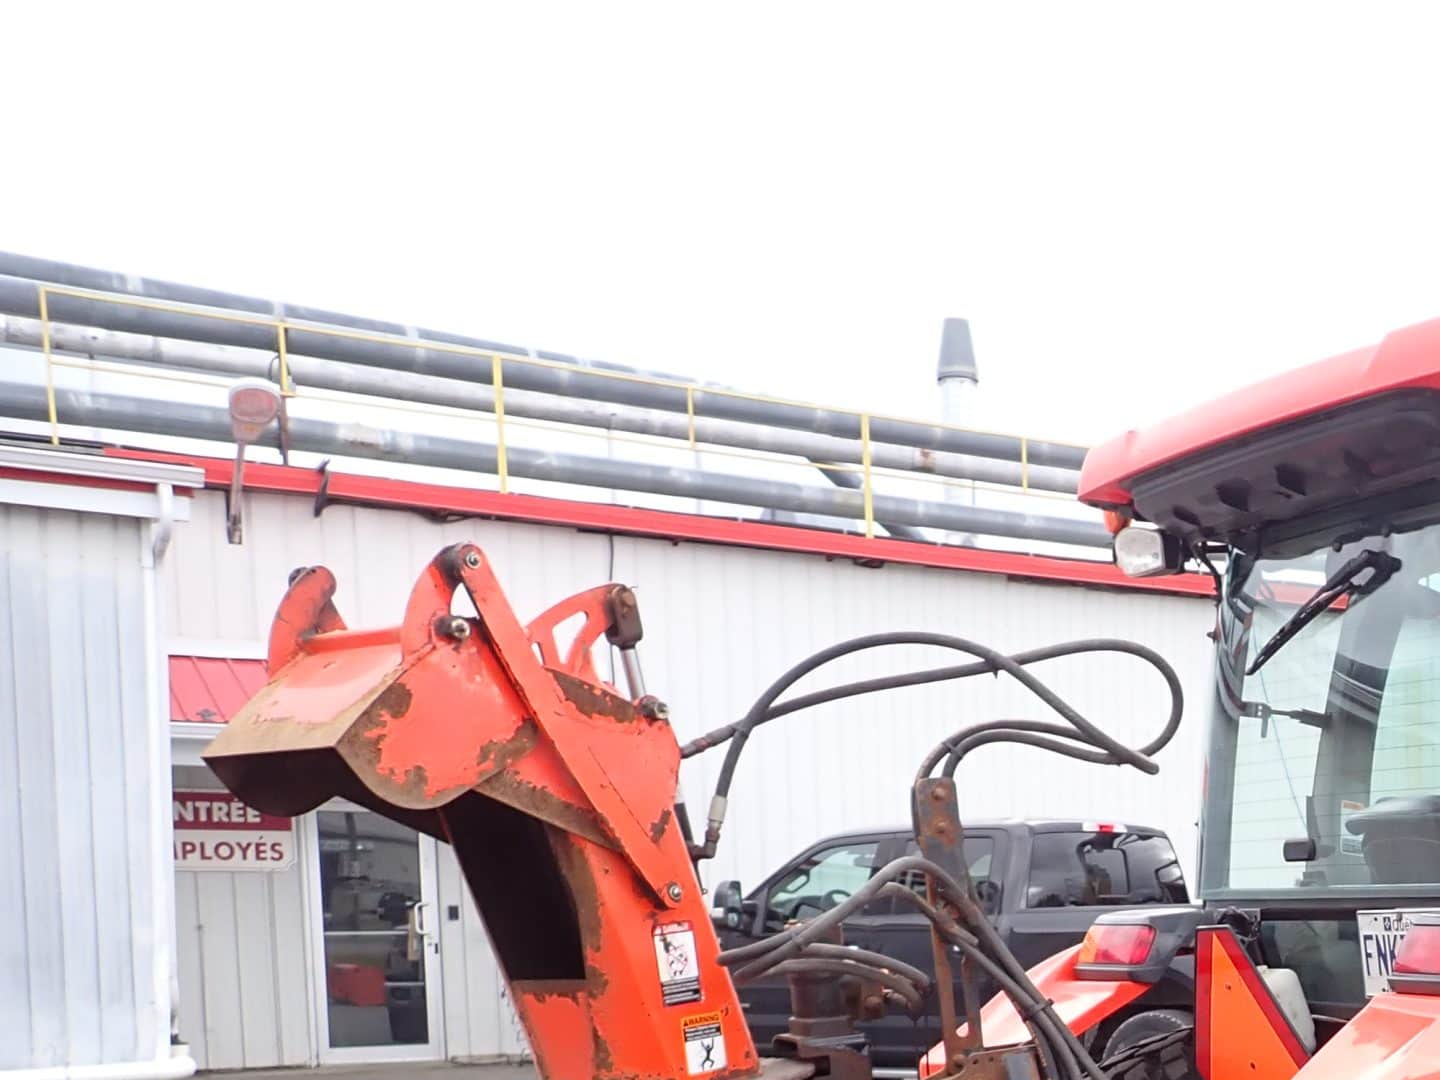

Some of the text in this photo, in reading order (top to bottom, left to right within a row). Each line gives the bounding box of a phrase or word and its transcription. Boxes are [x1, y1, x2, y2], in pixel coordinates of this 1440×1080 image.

[173, 797, 262, 823] NTRÉE
[174, 836, 284, 862] PLOYÉS
[1363, 934, 1406, 977] FNK
